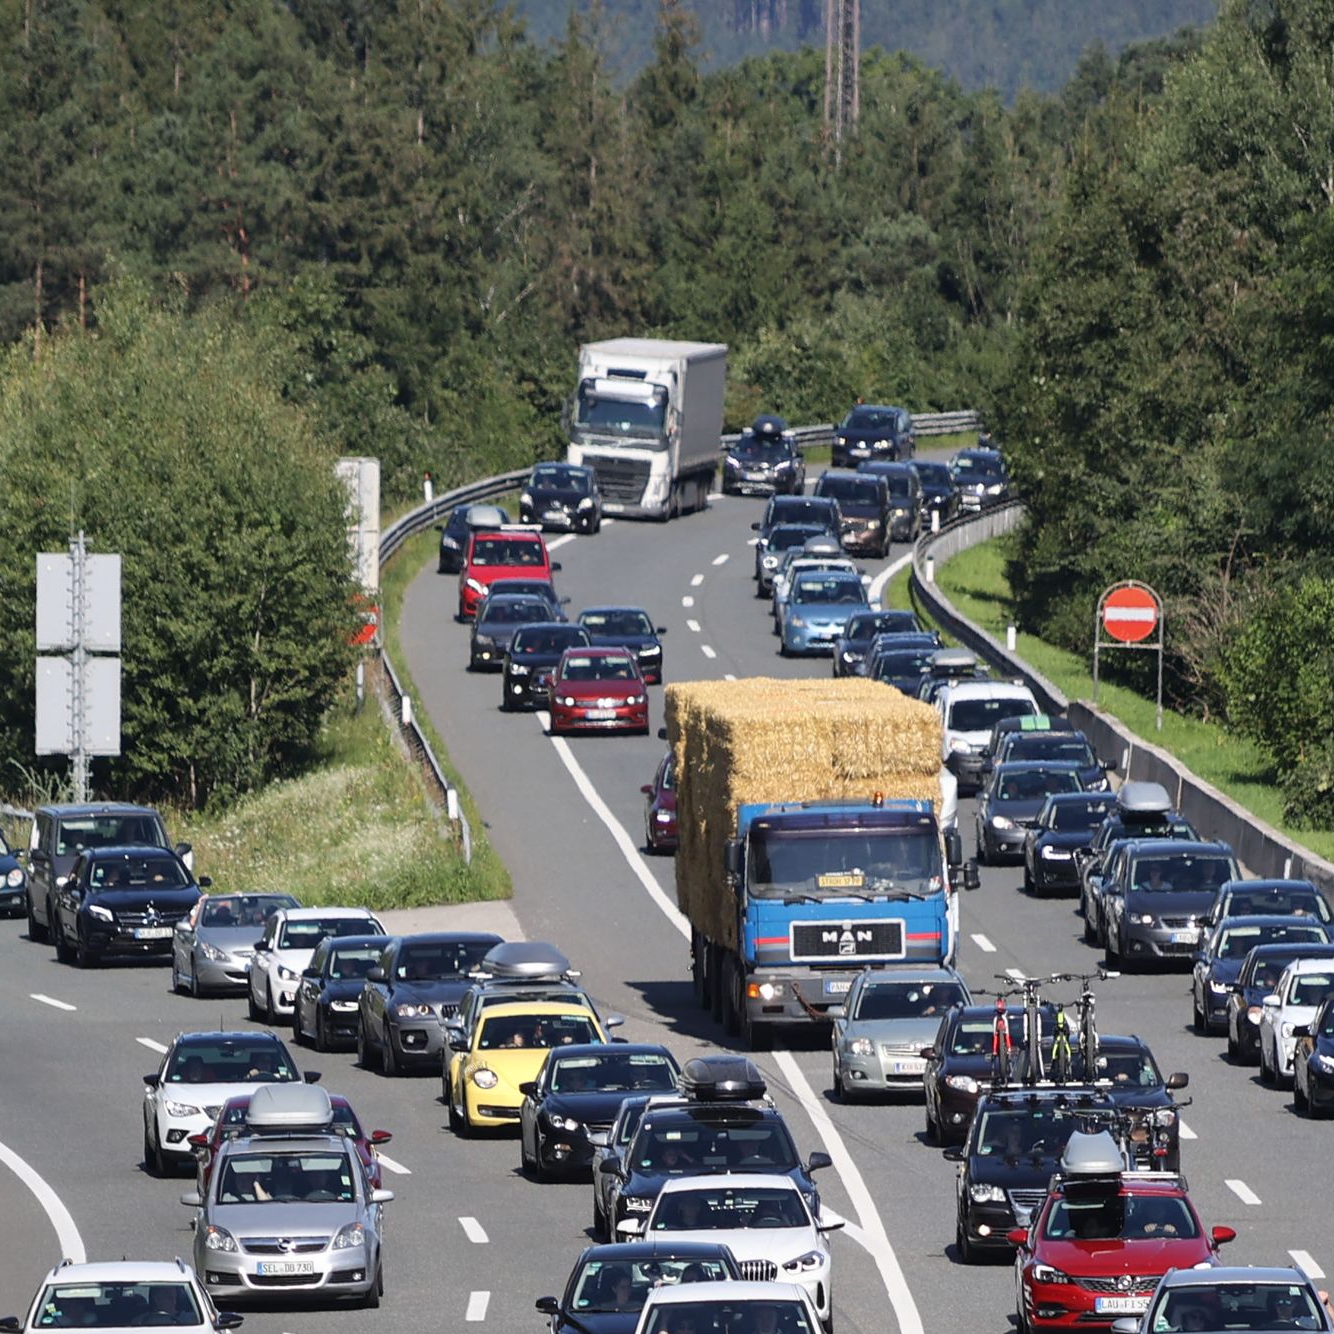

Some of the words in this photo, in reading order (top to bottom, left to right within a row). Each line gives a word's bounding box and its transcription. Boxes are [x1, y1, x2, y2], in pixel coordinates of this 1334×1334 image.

[822, 931, 873, 942] MAN
[262, 1263, 278, 1273] SEL
[297, 1262, 312, 1272] 730
[1101, 1298, 1119, 1309] LAU
